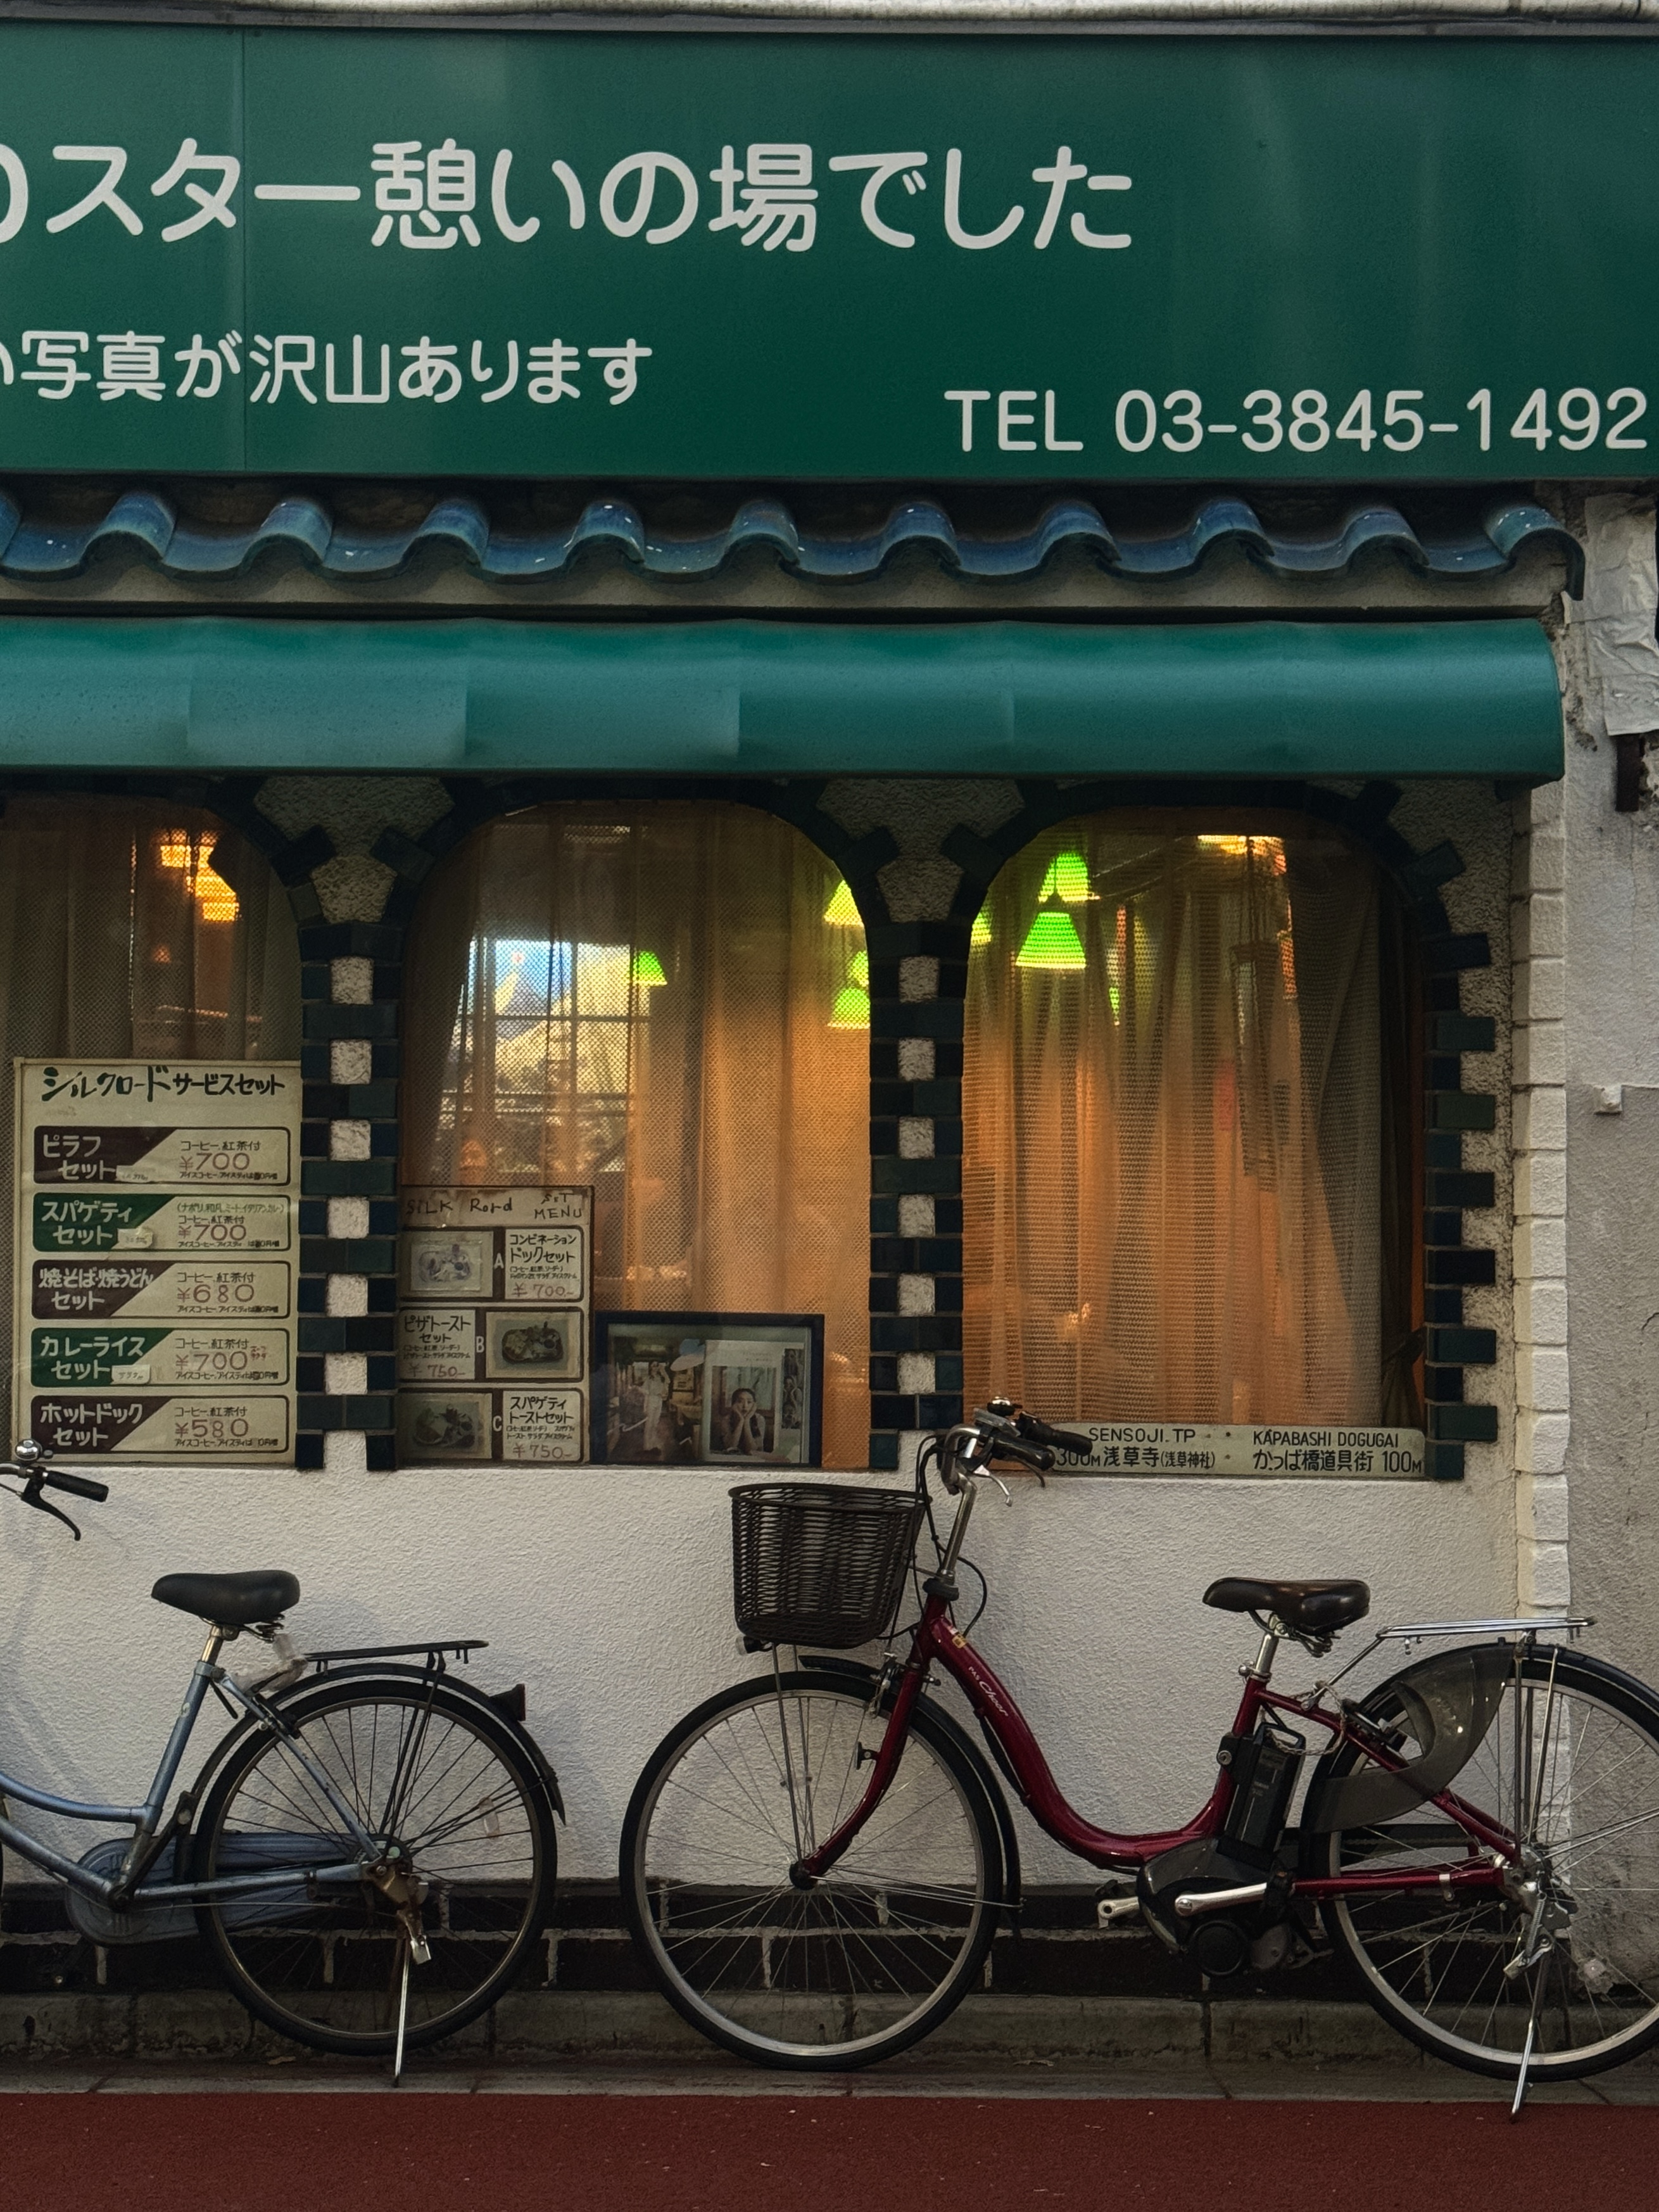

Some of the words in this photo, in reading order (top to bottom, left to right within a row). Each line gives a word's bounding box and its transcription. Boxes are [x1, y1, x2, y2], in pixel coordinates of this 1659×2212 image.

[0, 331, 652, 405] 写真が沢山あります
[944, 390, 1083, 452] TEL
[1115, 388, 1647, 453] 03-3845-1492
[43, 1134, 101, 1158] ピラフ
[58, 1160, 116, 1180] セット
[179, 1153, 250, 1170] ¥700
[41, 1201, 132, 1223] スパゲティ
[534, 1205, 582, 1220] MENU
[53, 1225, 113, 1246] セット
[178, 1224, 246, 1241] ¥700
[510, 1234, 577, 1245] コンビネーション
[494, 1253, 505, 1269] A
[51, 1291, 105, 1311] セット
[177, 1284, 255, 1303] ¥680
[404, 1315, 471, 1332] ピザトースト
[41, 1336, 146, 1358] カレーライス
[419, 1334, 451, 1343] セット
[476, 1336, 485, 1353] B
[51, 1360, 111, 1381] セット
[175, 1350, 248, 1371] ¥700
[510, 1396, 567, 1410] スパゲティ
[40, 1403, 144, 1424] ホットドック
[493, 1415, 503, 1432] C
[509, 1411, 575, 1424] トーストセット
[53, 1427, 109, 1447] セット
[175, 1418, 249, 1438] ¥580
[1253, 1431, 1332, 1446] KAPABASHI
[1337, 1432, 1399, 1448] DOGUGAI
[1252, 1448, 1374, 1472] かっぱ橋道具街
[1382, 1450, 1422, 1473] 100M
